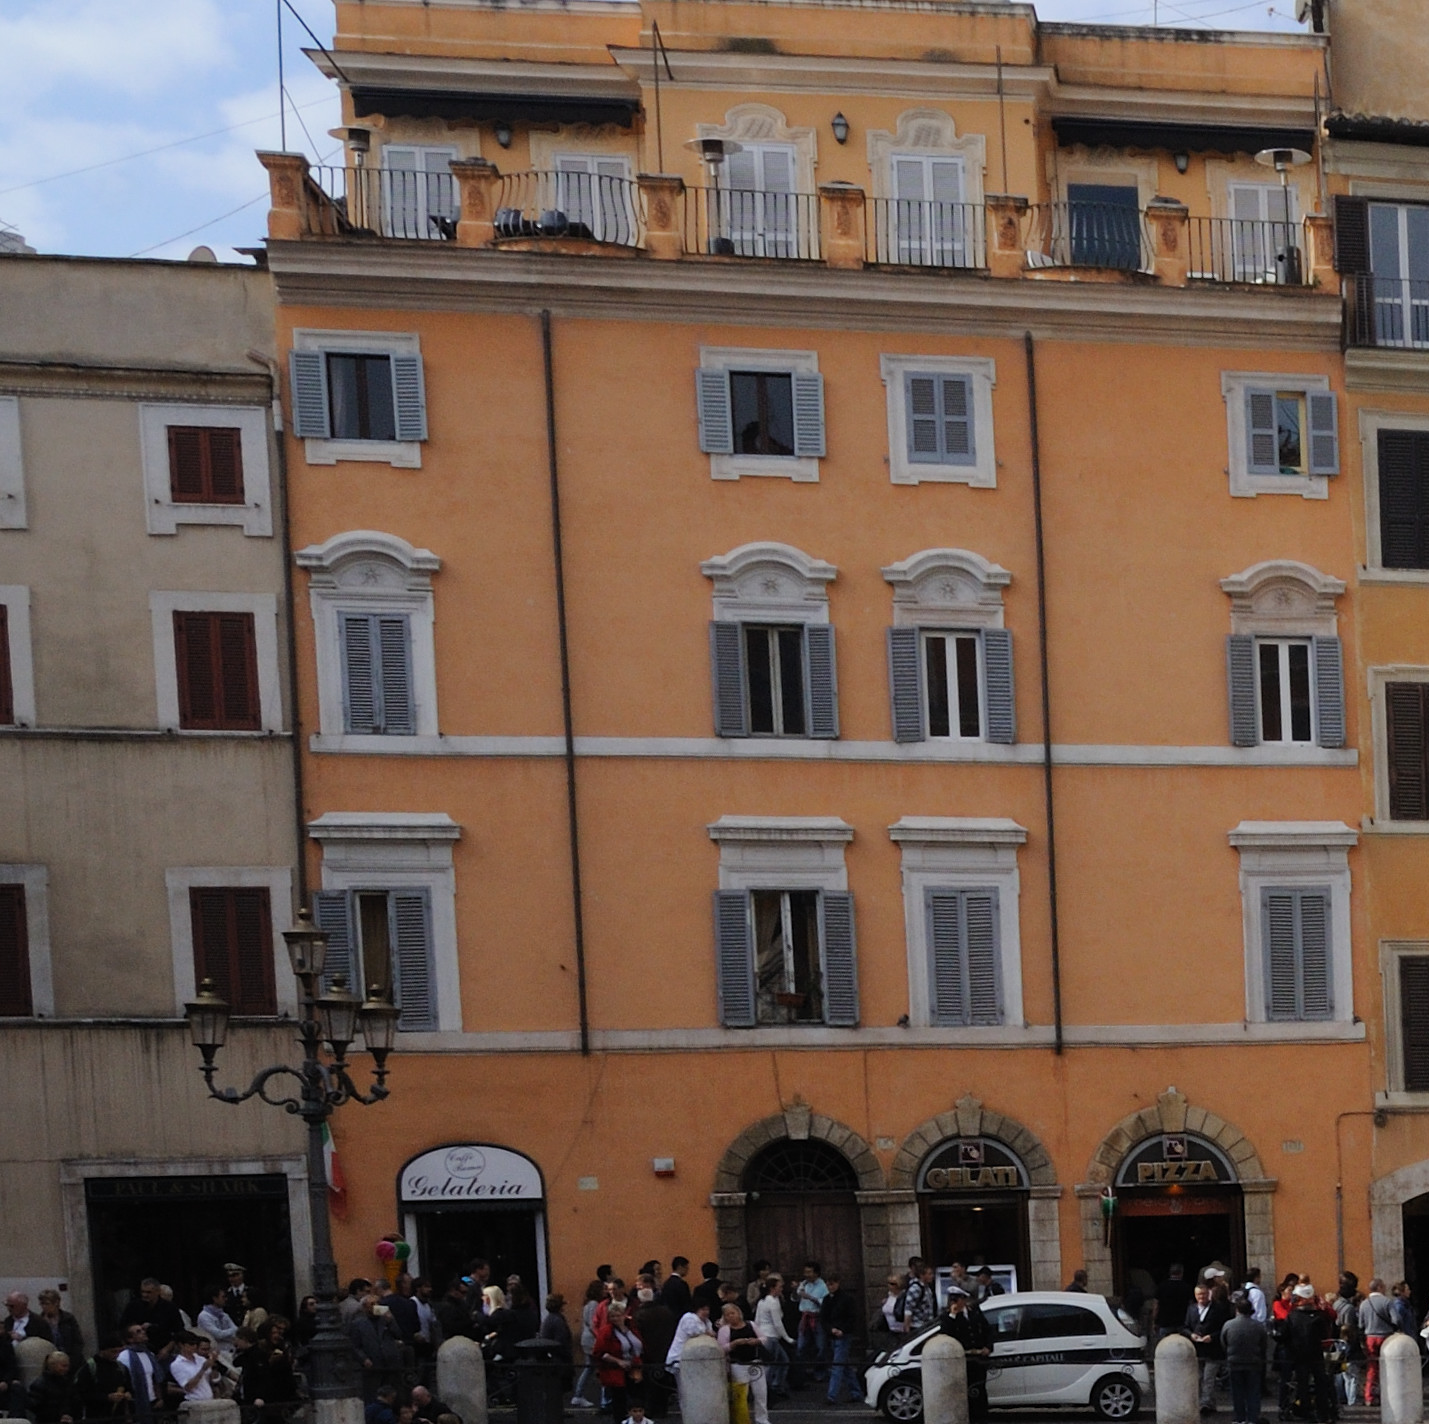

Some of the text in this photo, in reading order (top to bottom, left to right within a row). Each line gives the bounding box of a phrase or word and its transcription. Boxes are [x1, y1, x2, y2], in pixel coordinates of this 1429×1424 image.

[926, 1166, 1018, 1188] GELATI
[1137, 1160, 1219, 1183] PIZZA
[115, 1180, 261, 1194] PAUL & SHARK
[408, 1175, 525, 1196] Gelateria
